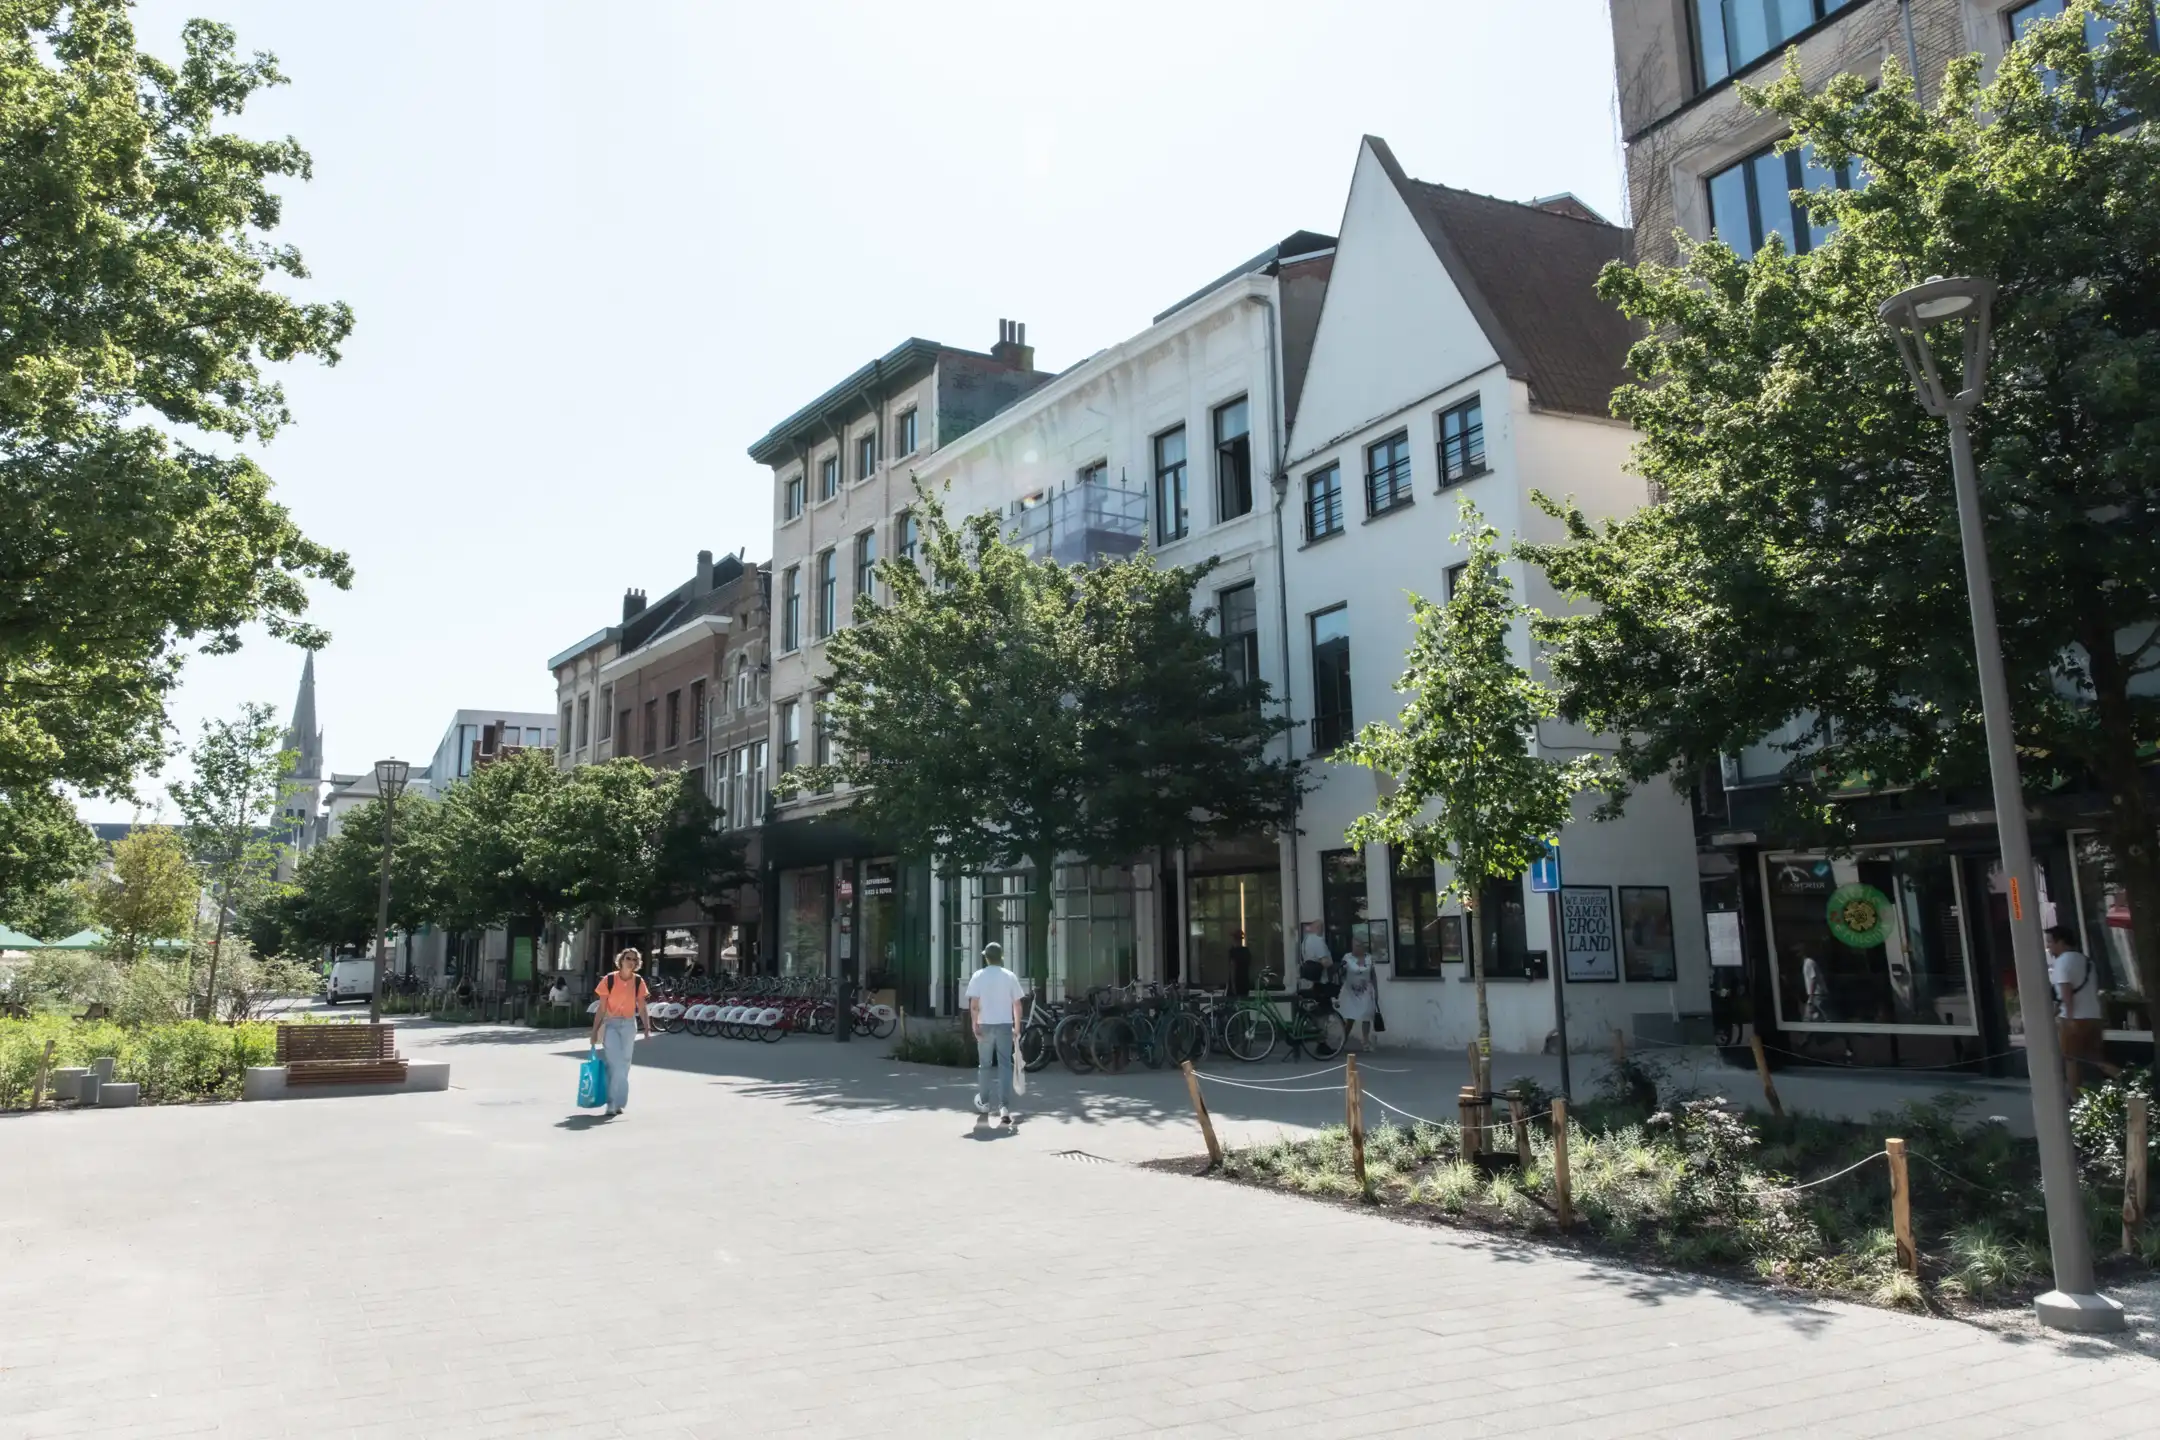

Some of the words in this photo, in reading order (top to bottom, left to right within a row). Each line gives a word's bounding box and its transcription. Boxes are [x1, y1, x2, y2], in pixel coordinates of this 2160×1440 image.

[1564, 896, 1577, 905] WE
[1566, 906, 1607, 917] SAMEN
[1568, 918, 1609, 934] ERCO-
[1569, 936, 1611, 952] LAND
